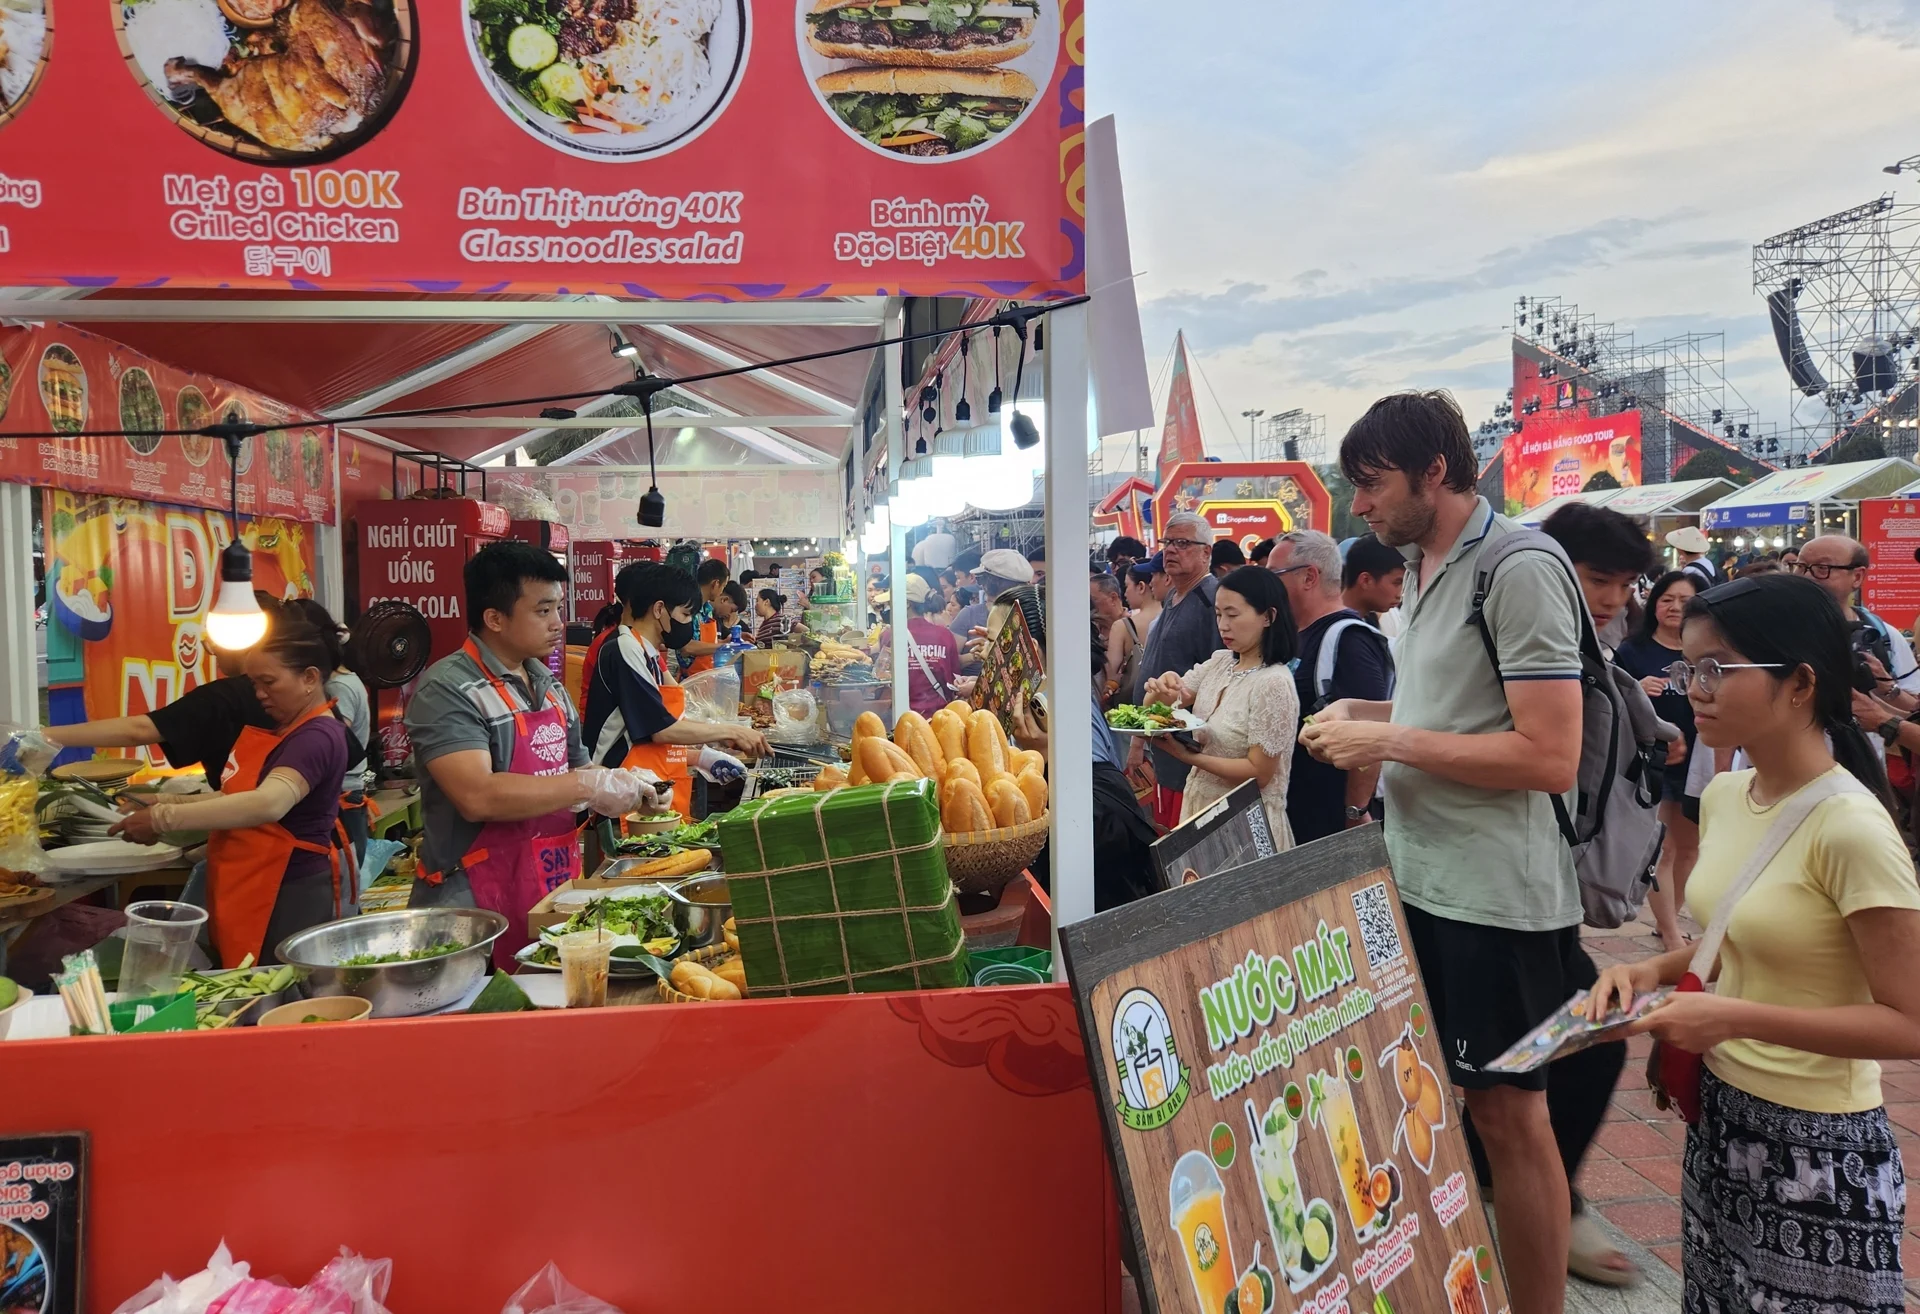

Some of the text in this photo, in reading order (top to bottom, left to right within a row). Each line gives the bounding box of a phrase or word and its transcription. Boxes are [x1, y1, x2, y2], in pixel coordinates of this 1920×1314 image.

[165, 170, 401, 215] Mẹt gà 100K
[460, 189, 741, 228] Bún Thịt nướng 40K
[172, 209, 398, 242] Grilled Chicken
[872, 196, 987, 226] Bánh mỳ
[245, 246, 330, 275] 닭구이
[462, 231, 741, 262] Glass noodles salad
[836, 223, 1024, 266] Đặc Biệt 40K
[1574, 433, 1593, 444] FOOD
[1594, 429, 1614, 441] TOUR
[1552, 474, 1580, 490] FOOD
[367, 518, 410, 548] NGHỈ
[413, 518, 457, 547] CHÚT
[388, 551, 434, 584] UỐNG
[582, 551, 603, 565] CHÚT
[575, 568, 592, 583] ỐNG
[368, 596, 460, 618] C-COLA
[573, 589, 604, 600] A-COLA
[541, 846, 569, 872] SAY
[1201, 920, 1353, 1048] NƯỚC MÁT
[1208, 1052, 1252, 1099] Nước
[1252, 1030, 1291, 1074] uống
[1289, 1022, 1304, 1054] từ
[1305, 1006, 1339, 1045] thiên
[1340, 987, 1374, 1026] nhiên
[1136, 1092, 1181, 1126] SÂM BÍ ĐAO
[24, 1163, 72, 1183] Chân
[1431, 1172, 1466, 1211] Dừa Xiêm
[1439, 1190, 1468, 1227] Coconut
[1353, 1213, 1418, 1283] Nước Chanh Dây
[1371, 1244, 1413, 1293] Lemonade
[1316, 1273, 1350, 1312] Chanh
